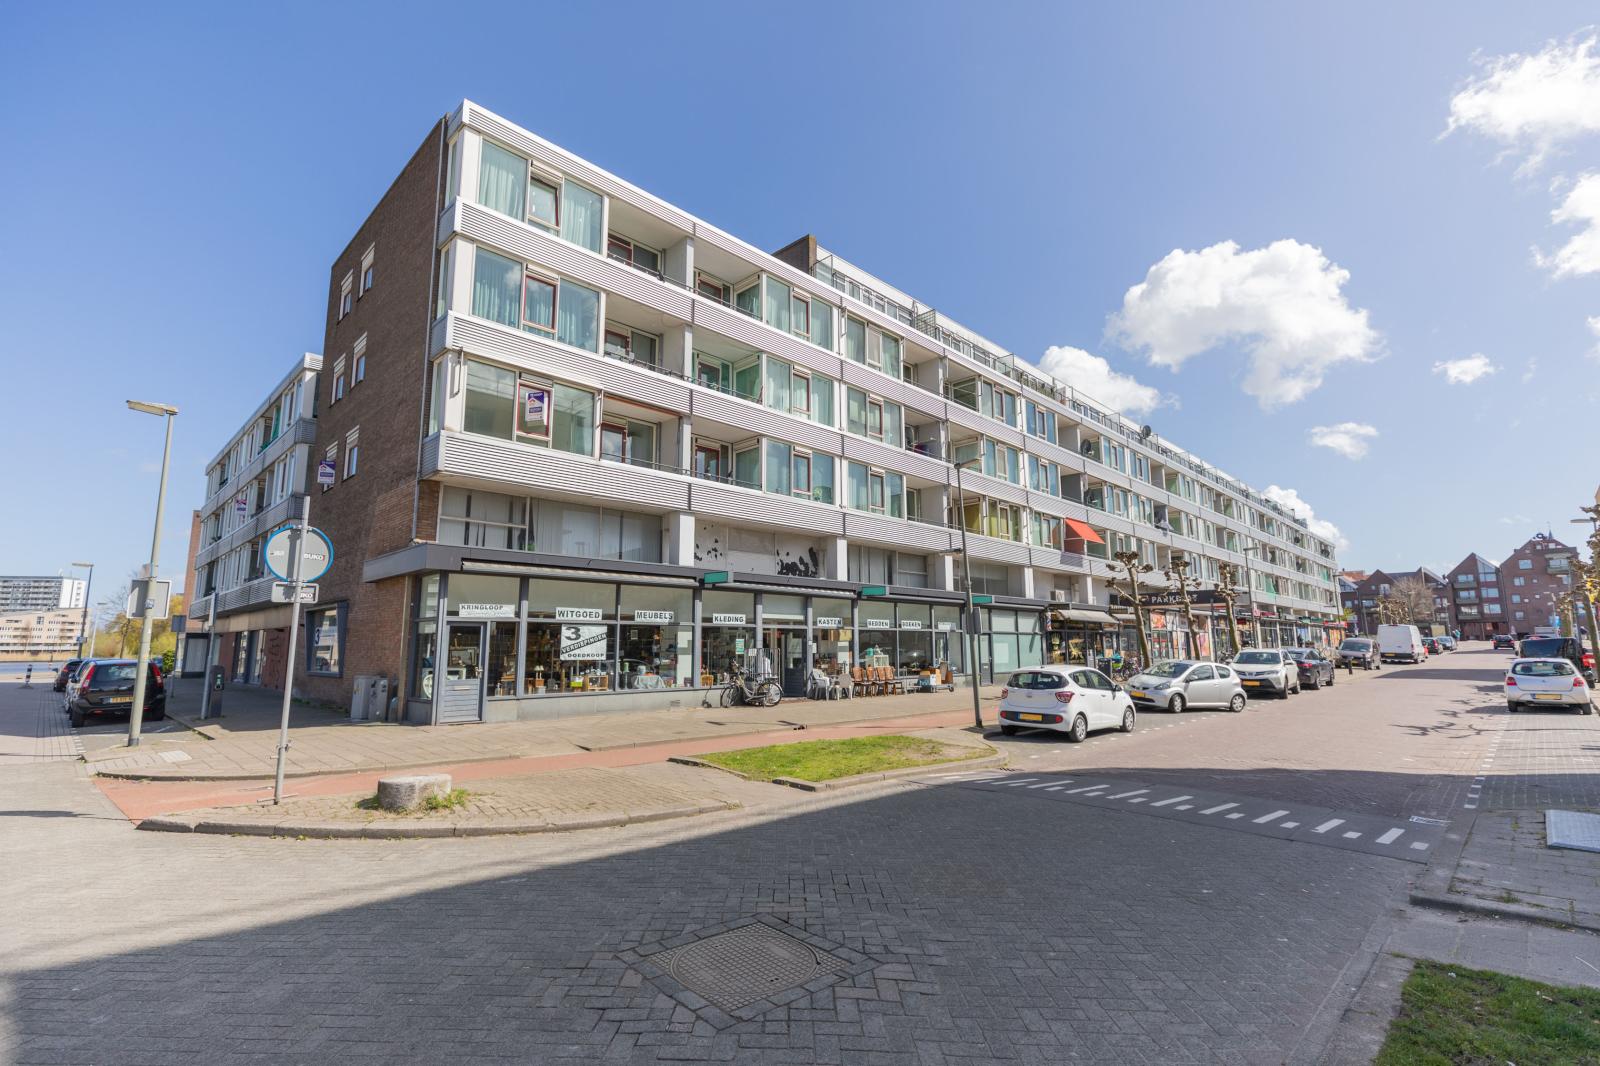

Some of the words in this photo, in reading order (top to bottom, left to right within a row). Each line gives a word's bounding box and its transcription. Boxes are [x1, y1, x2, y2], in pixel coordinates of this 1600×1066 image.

[558, 610, 600, 618] WITGOED
[636, 612, 673, 620] MEUBELS
[564, 626, 581, 640] 3
[562, 634, 606, 652] VERDIEPINGEN
